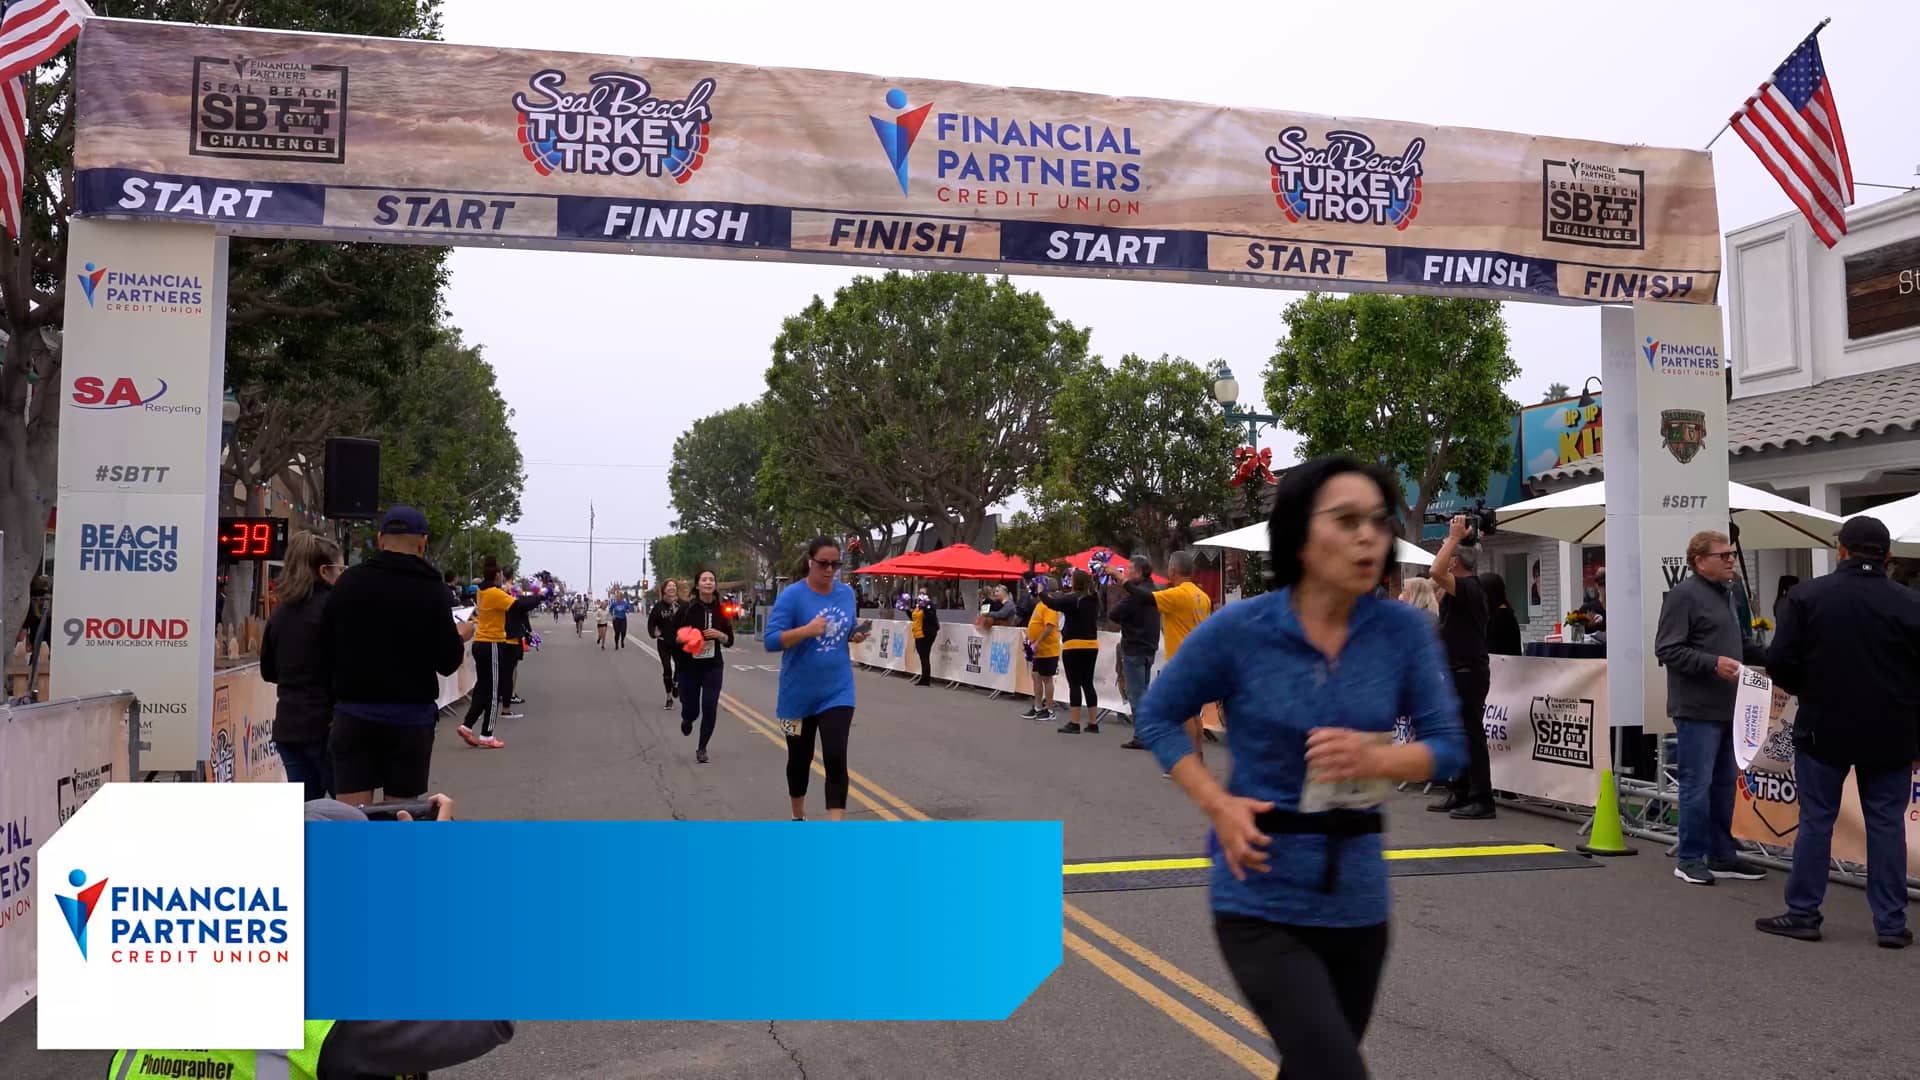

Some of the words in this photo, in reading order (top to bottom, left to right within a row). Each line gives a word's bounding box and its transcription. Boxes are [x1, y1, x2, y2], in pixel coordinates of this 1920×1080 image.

[250, 60, 307, 72] FINANCIAL
[250, 70, 306, 80] PARTNERS
[203, 81, 255, 95] SEAL
[269, 86, 337, 99] BEACH
[516, 72, 610, 117] Seal
[592, 74, 715, 120] Beach
[201, 93, 337, 135] SBTT
[283, 114, 322, 127] GYM
[529, 112, 695, 147] TURKEY
[937, 113, 1141, 155] FINANCIAL
[209, 134, 328, 151] CHALLENGE
[1269, 130, 1344, 169] Seal
[1328, 133, 1422, 175] Beach
[556, 142, 669, 174] TROT
[1580, 162, 1615, 174] FINANCIAL
[937, 149, 1141, 192] PARTNERS
[1280, 165, 1411, 200] TURKEY
[1580, 170, 1616, 181] PARTNERS
[118, 177, 272, 218] START
[937, 187, 1039, 207] CREDIT
[1057, 194, 1140, 215] UNION
[1550, 180, 1585, 192] SEAL
[1593, 185, 1637, 198] BEACH
[373, 195, 515, 230] START
[1303, 192, 1391, 222] TROT
[1550, 190, 1637, 227] SBTT
[1601, 208, 1628, 220] GYM
[603, 206, 749, 241] FINISH
[829, 217, 967, 254] FINISH
[1555, 225, 1632, 240] CHALLENGE
[1046, 230, 1165, 264] START
[1246, 242, 1353, 275] START
[107, 271, 202, 289] FINANCIAL
[1423, 255, 1528, 288] FINISH
[107, 288, 202, 304] PARTNERS
[1583, 271, 1693, 298] FINISH
[107, 303, 152, 311] CREDIT
[1661, 344, 1719, 356] FINANCIAL
[1661, 357, 1719, 368] PARTNERS
[72, 376, 143, 405] SA
[145, 403, 201, 415] Recycling
[1564, 409, 1579, 426] UP
[1584, 405, 1599, 422] UP
[96, 465, 170, 482] #SBTT
[1662, 495, 1707, 508] #SBTT
[81, 523, 178, 549] BEACH
[230, 523, 270, 554] 39
[80, 548, 178, 572] FITNESS
[1661, 556, 1683, 565] WEST
[63, 618, 189, 646] 9ROUND
[155, 640, 188, 648] FITNESS
[124, 703, 187, 714] NINGS
[1534, 712, 1559, 720] SEAL
[1563, 714, 1589, 723] BEACH
[1485, 723, 1507, 740] ERS
[1537, 720, 1588, 748] SBTT
[1539, 747, 1585, 760] CHALLENGE
[1755, 776, 1798, 801] TRO
[139, 1053, 234, 1080] Photographer
